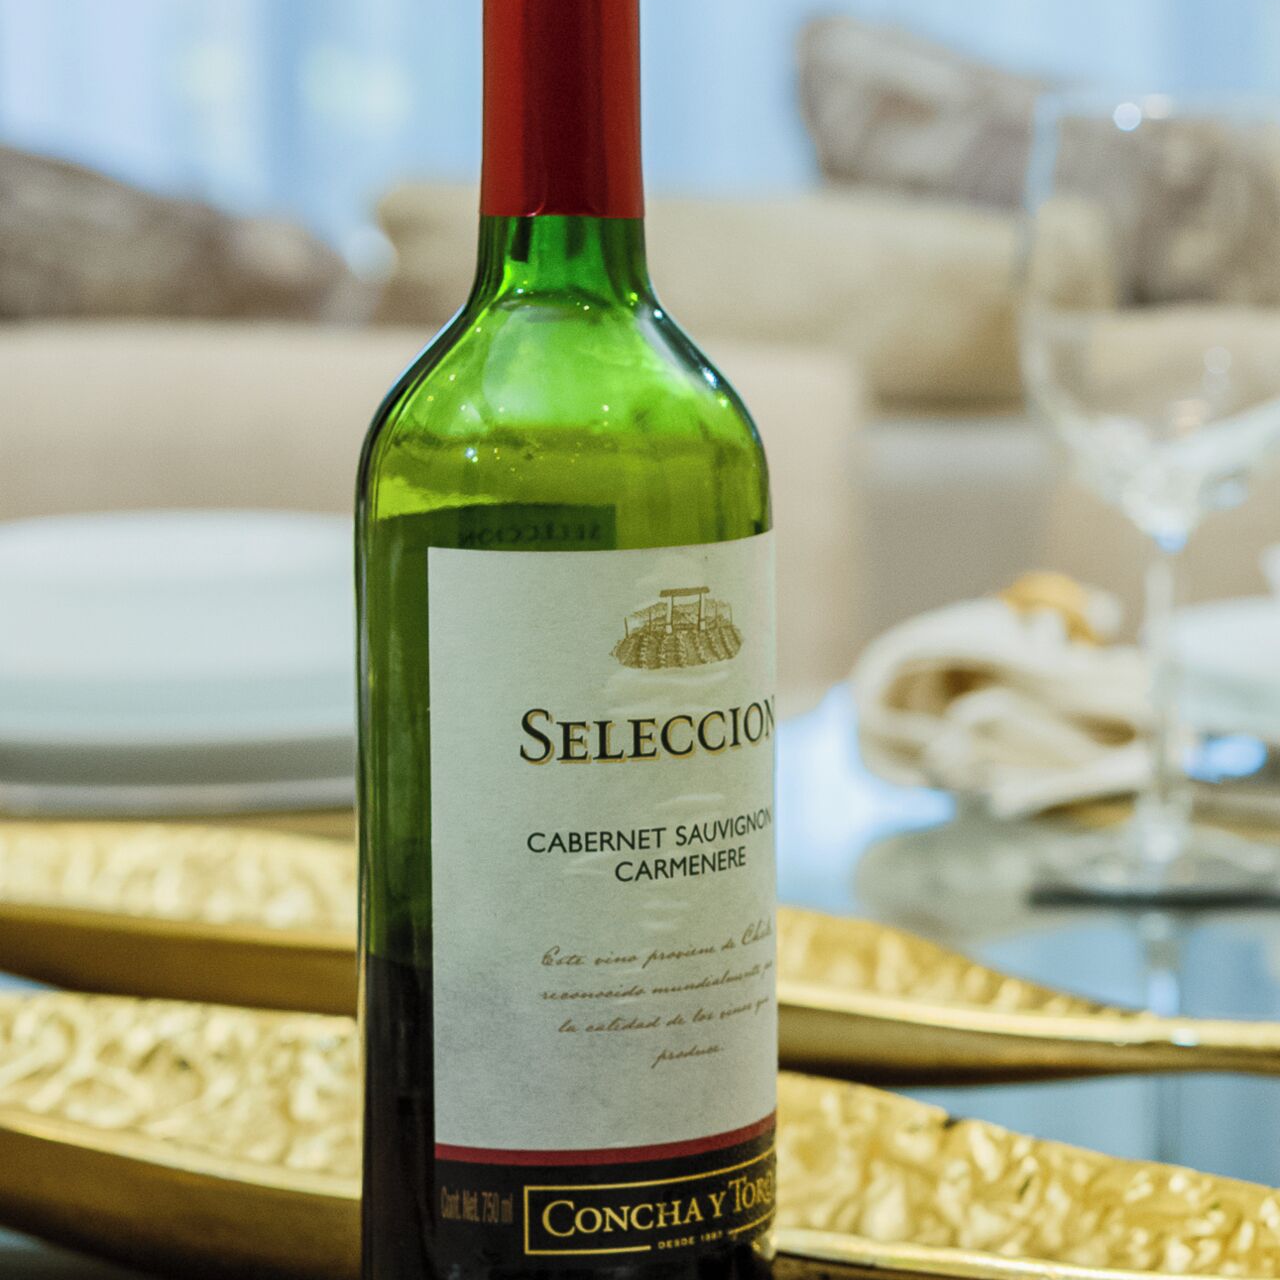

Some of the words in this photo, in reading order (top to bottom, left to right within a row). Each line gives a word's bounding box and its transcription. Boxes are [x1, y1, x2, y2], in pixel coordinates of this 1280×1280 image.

[519, 694, 775, 765] SELECCION
[526, 826, 667, 854] CABERNET
[675, 806, 772, 847] SAUVIGNON
[614, 846, 747, 883] CARMENERE
[541, 945, 585, 967] Este
[594, 950, 638, 966] vino
[641, 943, 717, 969] proviene
[720, 937, 736, 951] de
[540, 984, 645, 1000] reconocido
[558, 1017, 577, 1033] la
[666, 1014, 686, 1027] de
[692, 1008, 714, 1023] los
[541, 1196, 704, 1238] CONCHA
[708, 1190, 727, 1218] Y
[657, 1235, 696, 1250] DESDE
